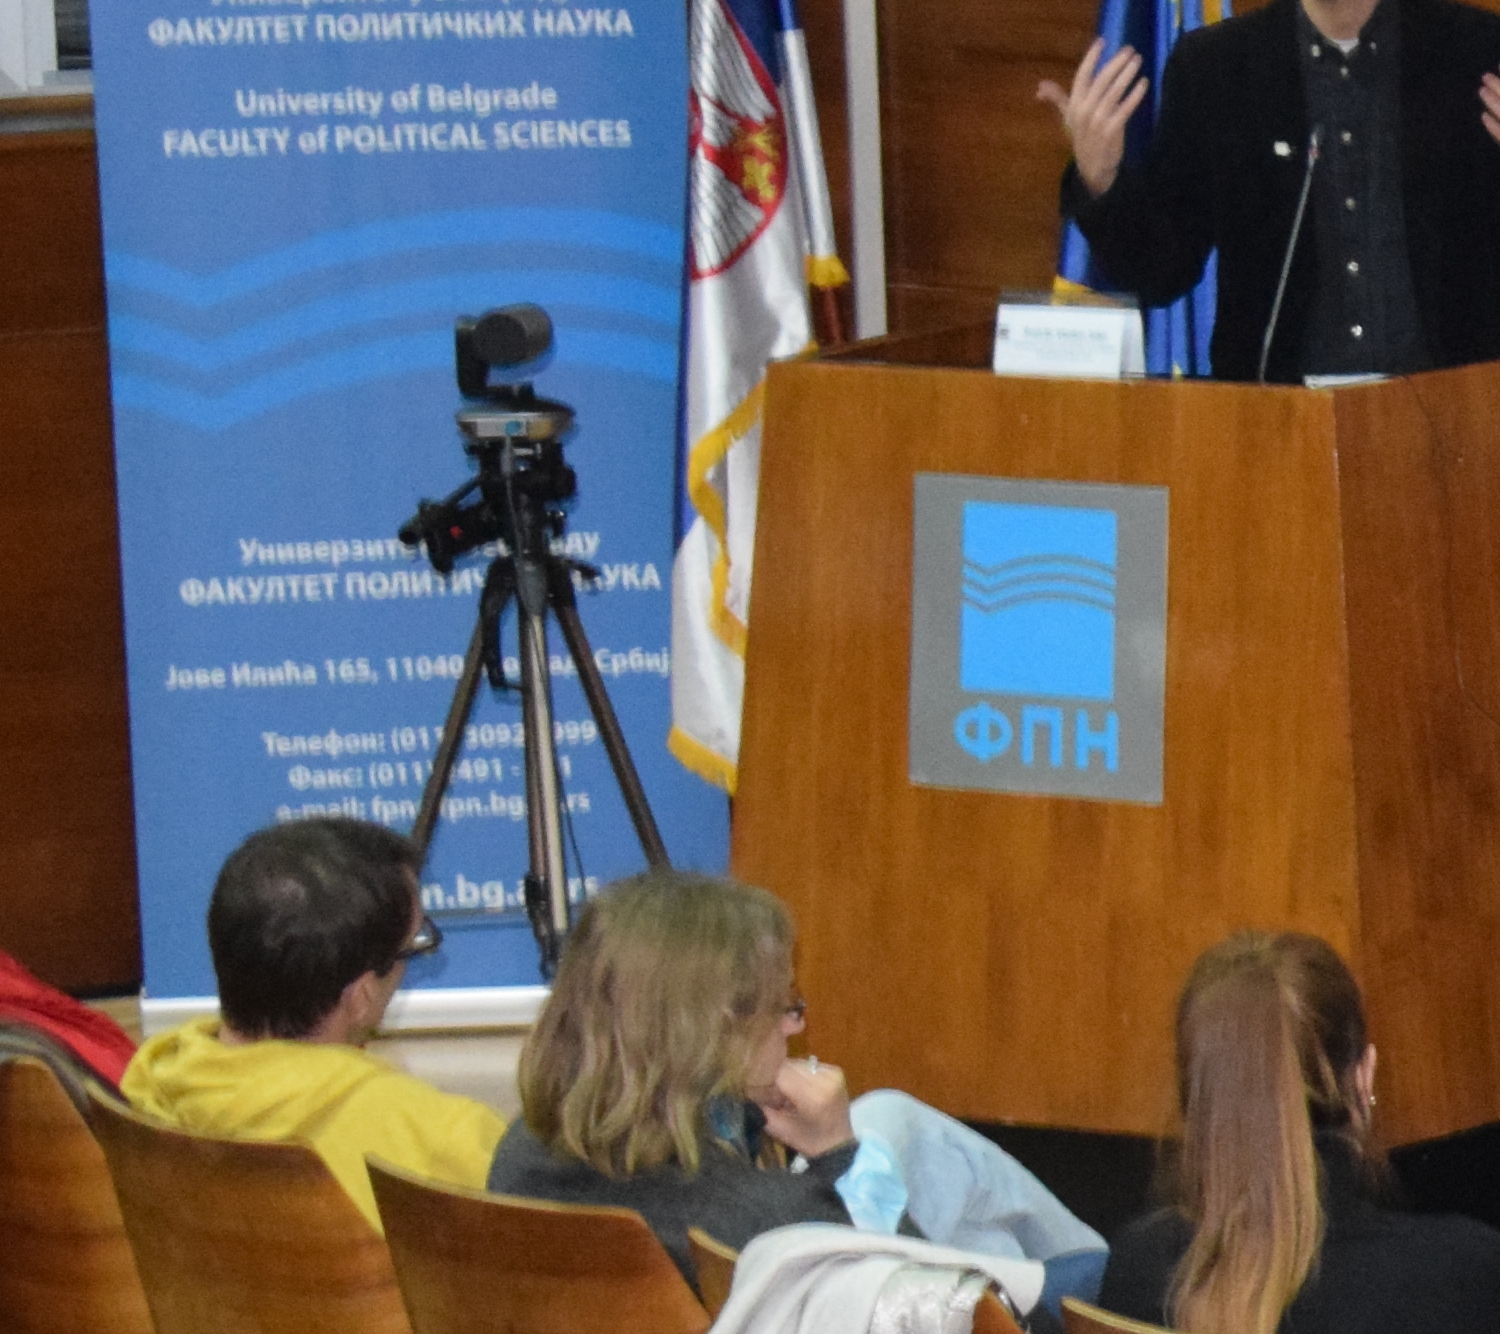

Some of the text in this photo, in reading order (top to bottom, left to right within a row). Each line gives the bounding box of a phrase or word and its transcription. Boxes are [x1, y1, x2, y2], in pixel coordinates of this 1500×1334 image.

[148, 9, 635, 47] ФАКУЛТЕТ ПОЛИТИЧКИХ НАУКА
[235, 82, 559, 119] University of Belgrade
[163, 120, 633, 158] FACULTY of POLITICAL SCIENCES
[181, 573, 338, 606] ФАКУЛТЕТ
[165, 665, 226, 690] Јове
[231, 659, 317, 688] Илића
[325, 656, 379, 685] 165,
[263, 728, 386, 758] Телефон:
[955, 701, 1119, 774] ФПН
[288, 764, 364, 790] Факс:
